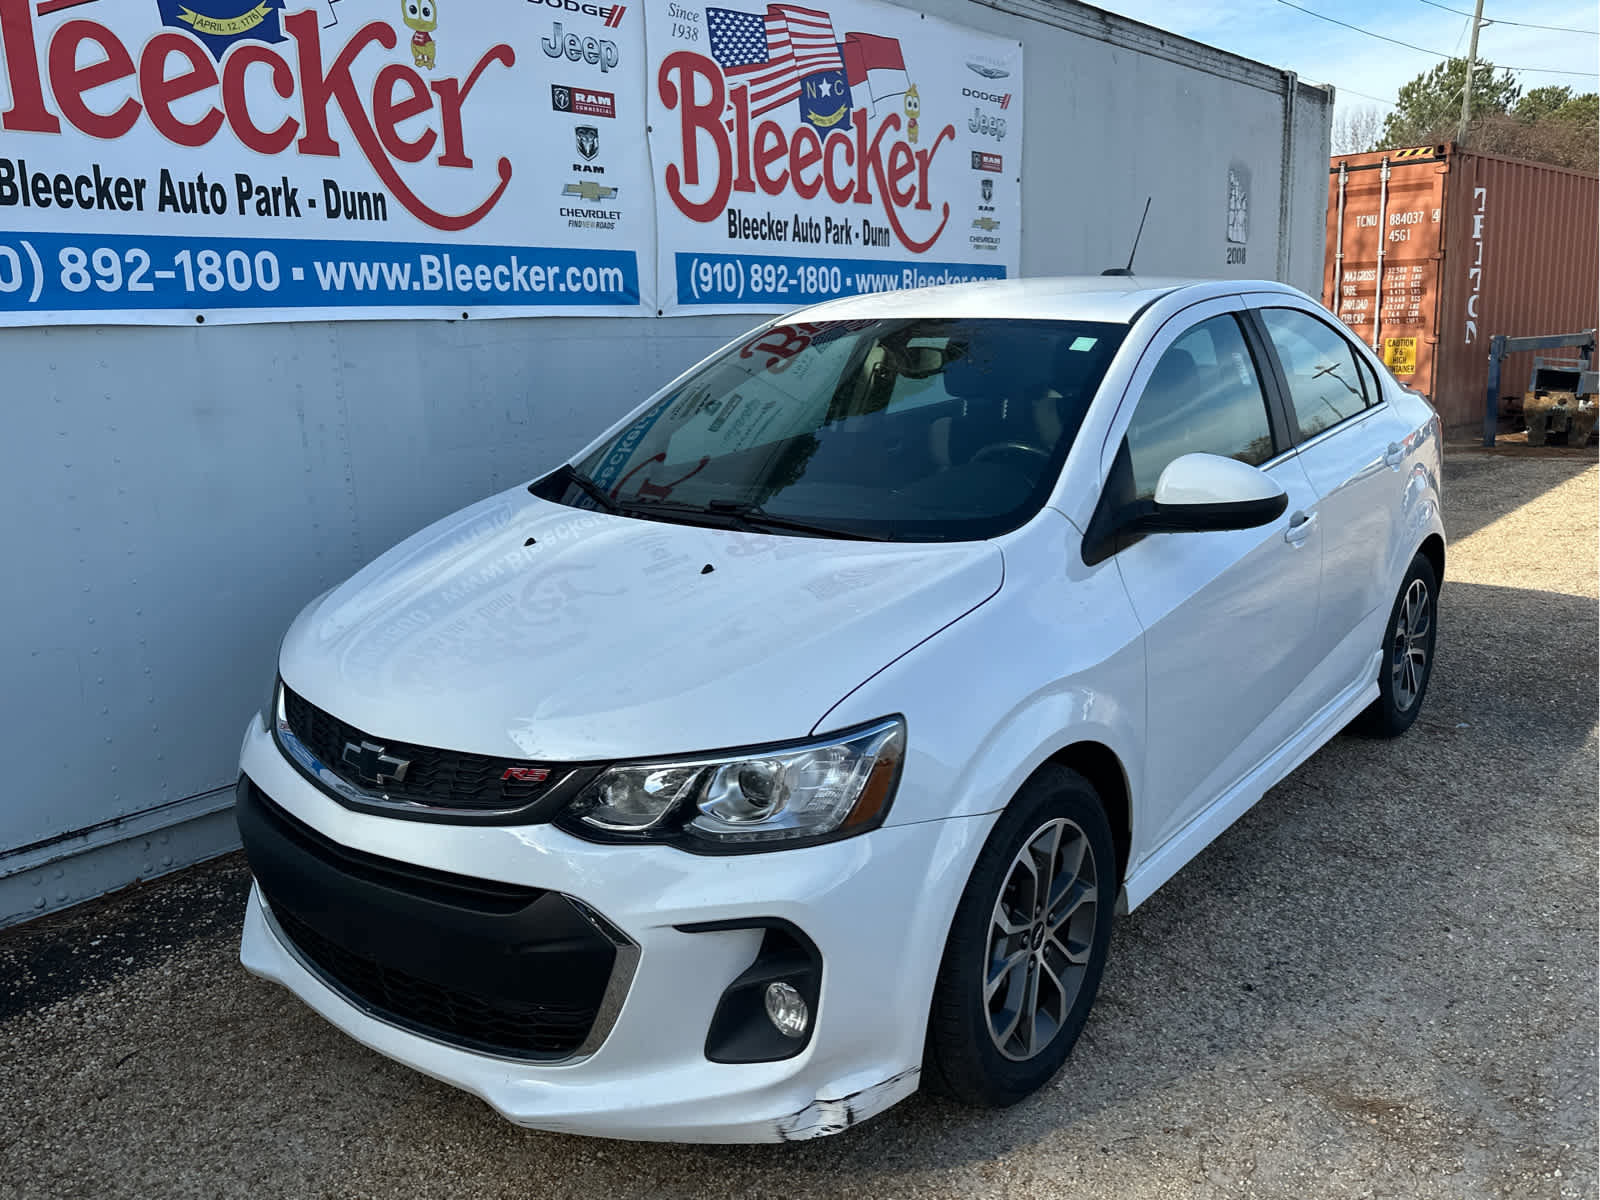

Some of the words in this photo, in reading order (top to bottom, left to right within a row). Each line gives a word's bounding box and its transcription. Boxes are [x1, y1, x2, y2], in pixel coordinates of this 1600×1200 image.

[527, 0, 613, 19] ODGE
[668, 2, 700, 22] Since
[196, 18, 224, 31] APRIL
[241, 13, 259, 27] 1776
[672, 23, 699, 41] 1938
[541, 21, 619, 73] Jeep
[806, 81, 817, 98] N
[834, 80, 844, 96] C
[962, 88, 1005, 104] DODGE
[575, 92, 611, 106] RAM
[968, 107, 1007, 142] Jeep
[658, 50, 955, 253] Bleecker
[572, 164, 604, 174] RAM
[0, 158, 147, 212] Bleecker
[158, 168, 227, 216] Auto
[234, 173, 301, 218] Park
[323, 179, 388, 221] Dunn
[560, 207, 622, 220] CHEVROLET
[1356, 215, 1378, 228] TCNU
[1390, 211, 1424, 226] 884037
[728, 208, 789, 242] Bleecker
[792, 213, 821, 244] Auto
[824, 216, 852, 245] Park
[863, 219, 890, 247] Dunn
[58, 246, 280, 293] 892-1800
[313, 253, 624, 292] www.Bleecker.com
[690, 258, 745, 299] (910)
[750, 263, 842, 294] 892-1800
[500, 767, 551, 781] RS
